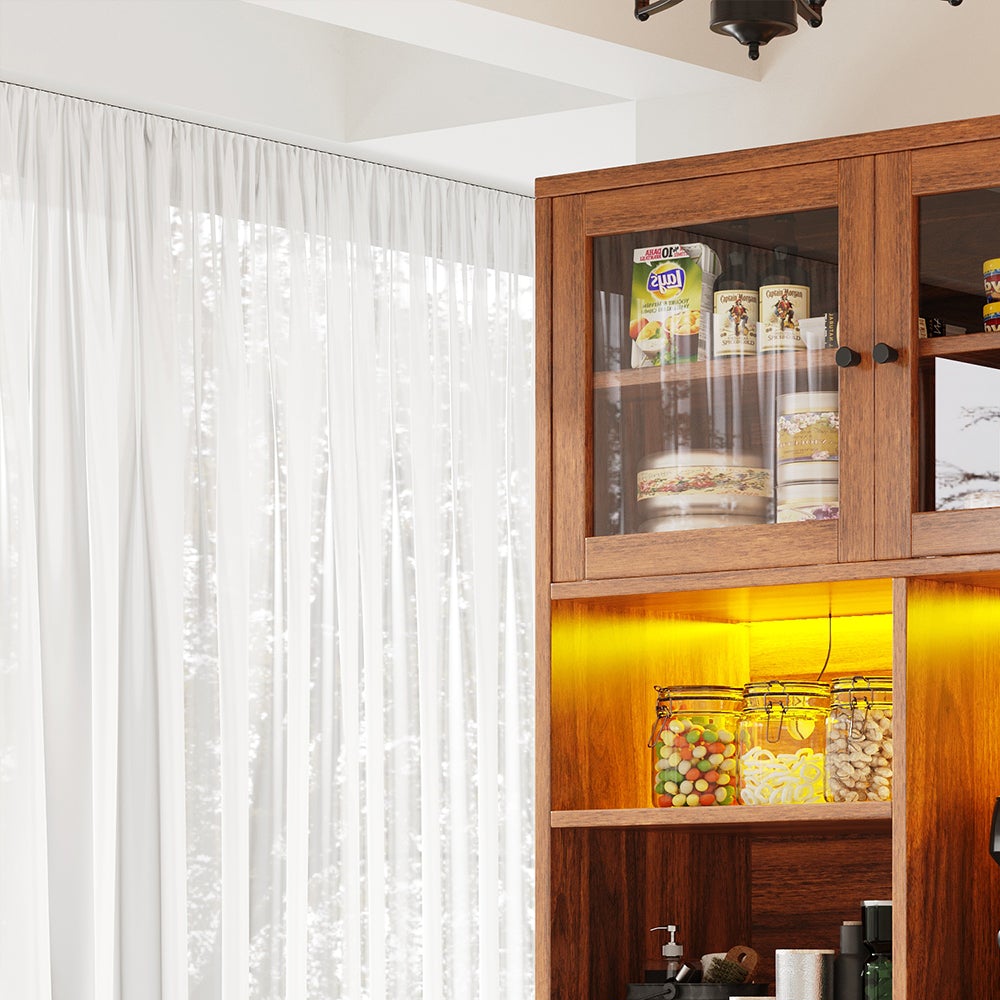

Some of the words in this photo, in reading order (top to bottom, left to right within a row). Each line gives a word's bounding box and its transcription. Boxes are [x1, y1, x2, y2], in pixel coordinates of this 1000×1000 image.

[766, 290, 783, 298] Captain
[784, 288, 803, 298] Morgan
[720, 294, 738, 304] Captain
